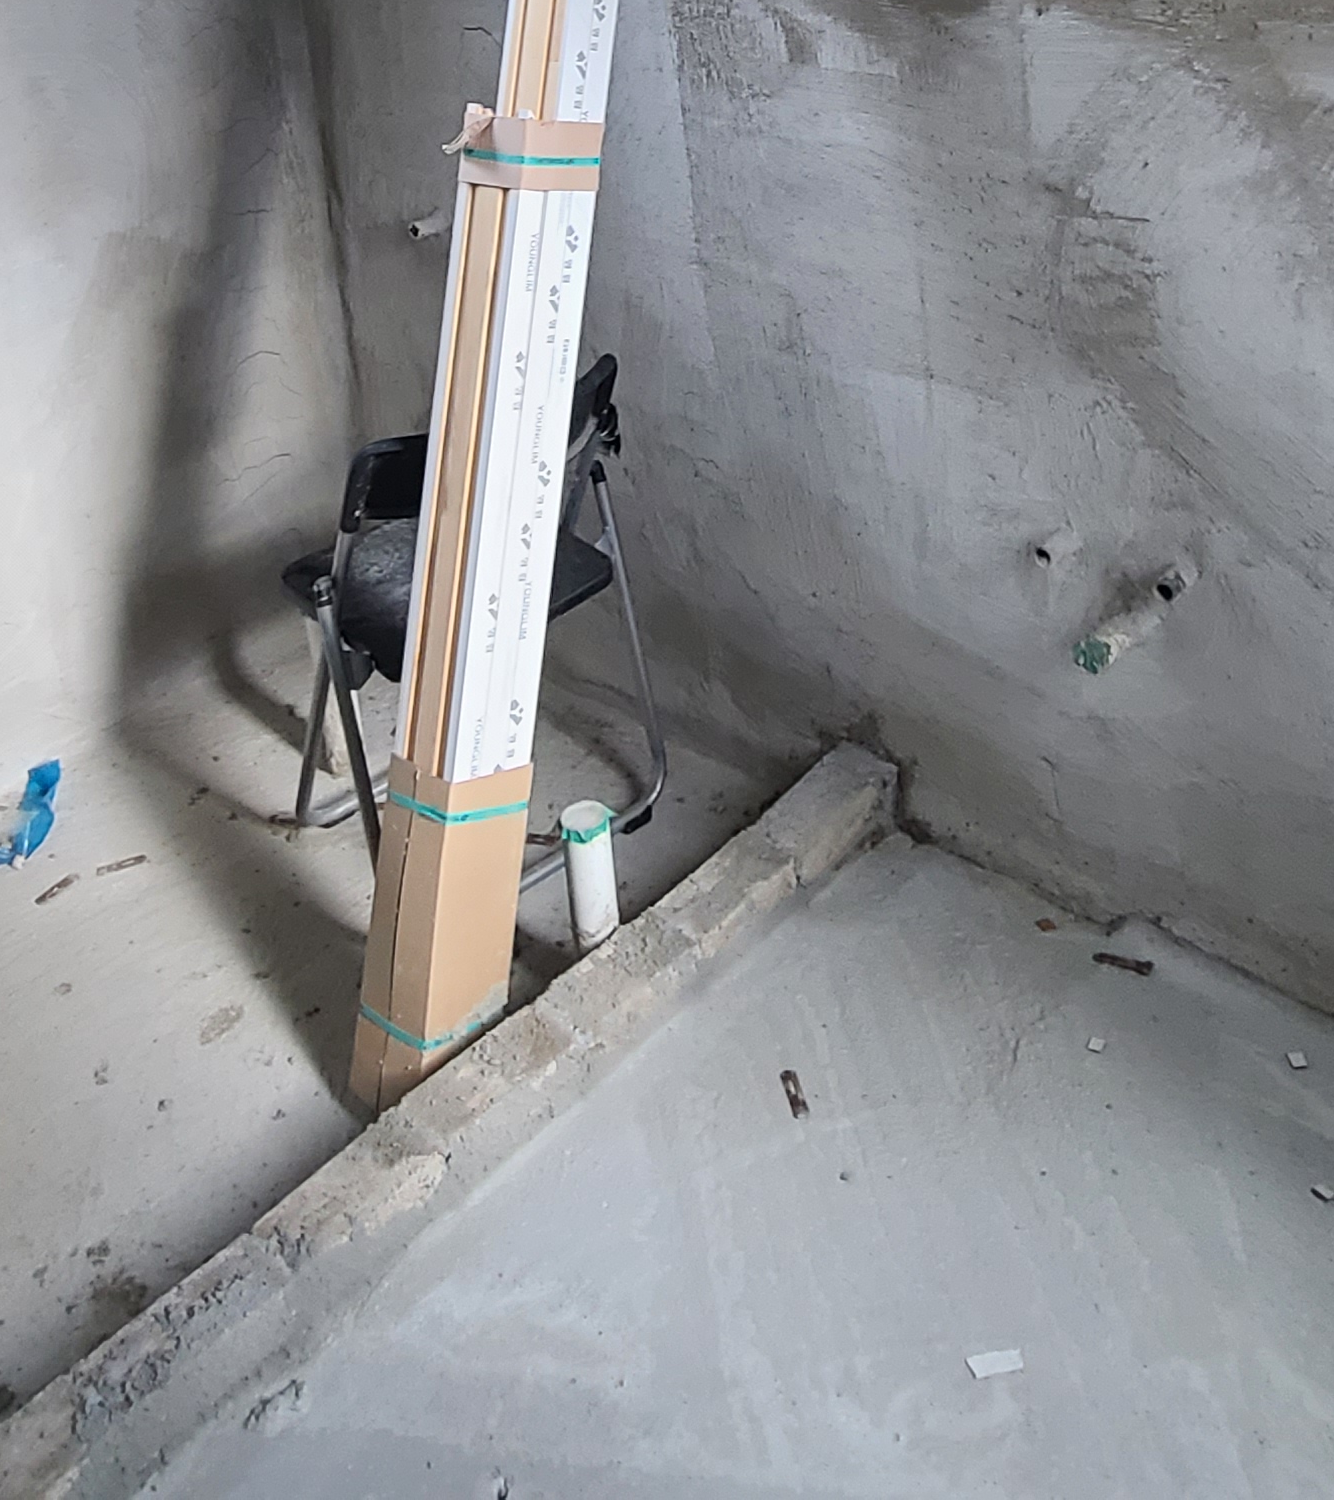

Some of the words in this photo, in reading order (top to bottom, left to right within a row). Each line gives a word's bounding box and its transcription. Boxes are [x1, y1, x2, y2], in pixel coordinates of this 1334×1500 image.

[525, 233, 538, 292] YOUNGLIM
[531, 405, 544, 464] YOUNGLIM
[519, 581, 532, 640] YOUNGLIM
